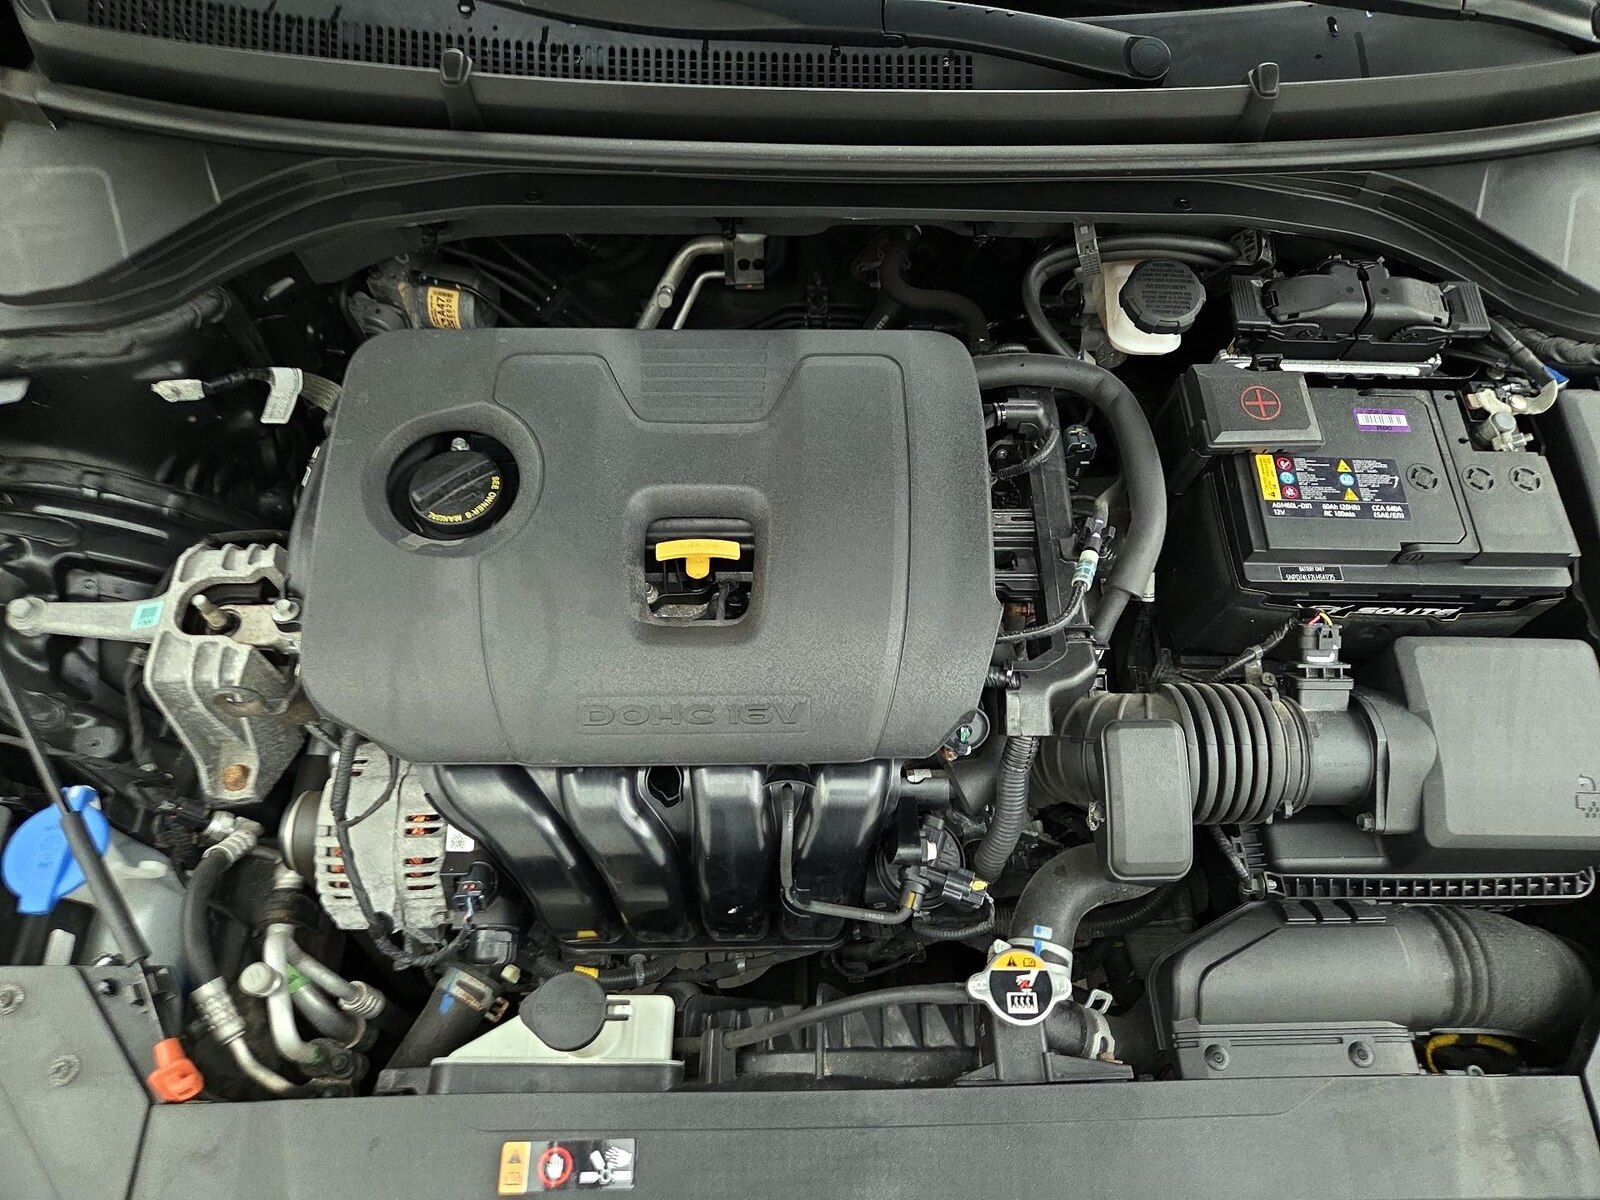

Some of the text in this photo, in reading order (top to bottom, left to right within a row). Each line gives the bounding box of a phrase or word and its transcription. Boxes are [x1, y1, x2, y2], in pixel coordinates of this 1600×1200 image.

[490, 475, 500, 490] SEE
[464, 491, 497, 519] OWNER'S
[1322, 503, 1339, 511] 60Ah
[1371, 504, 1386, 512] CCA
[1273, 508, 1286, 516] 12V
[1334, 510, 1356, 518] 100min
[1357, 607, 1463, 616] SOLITE
[582, 702, 804, 726] DOHC 16V
